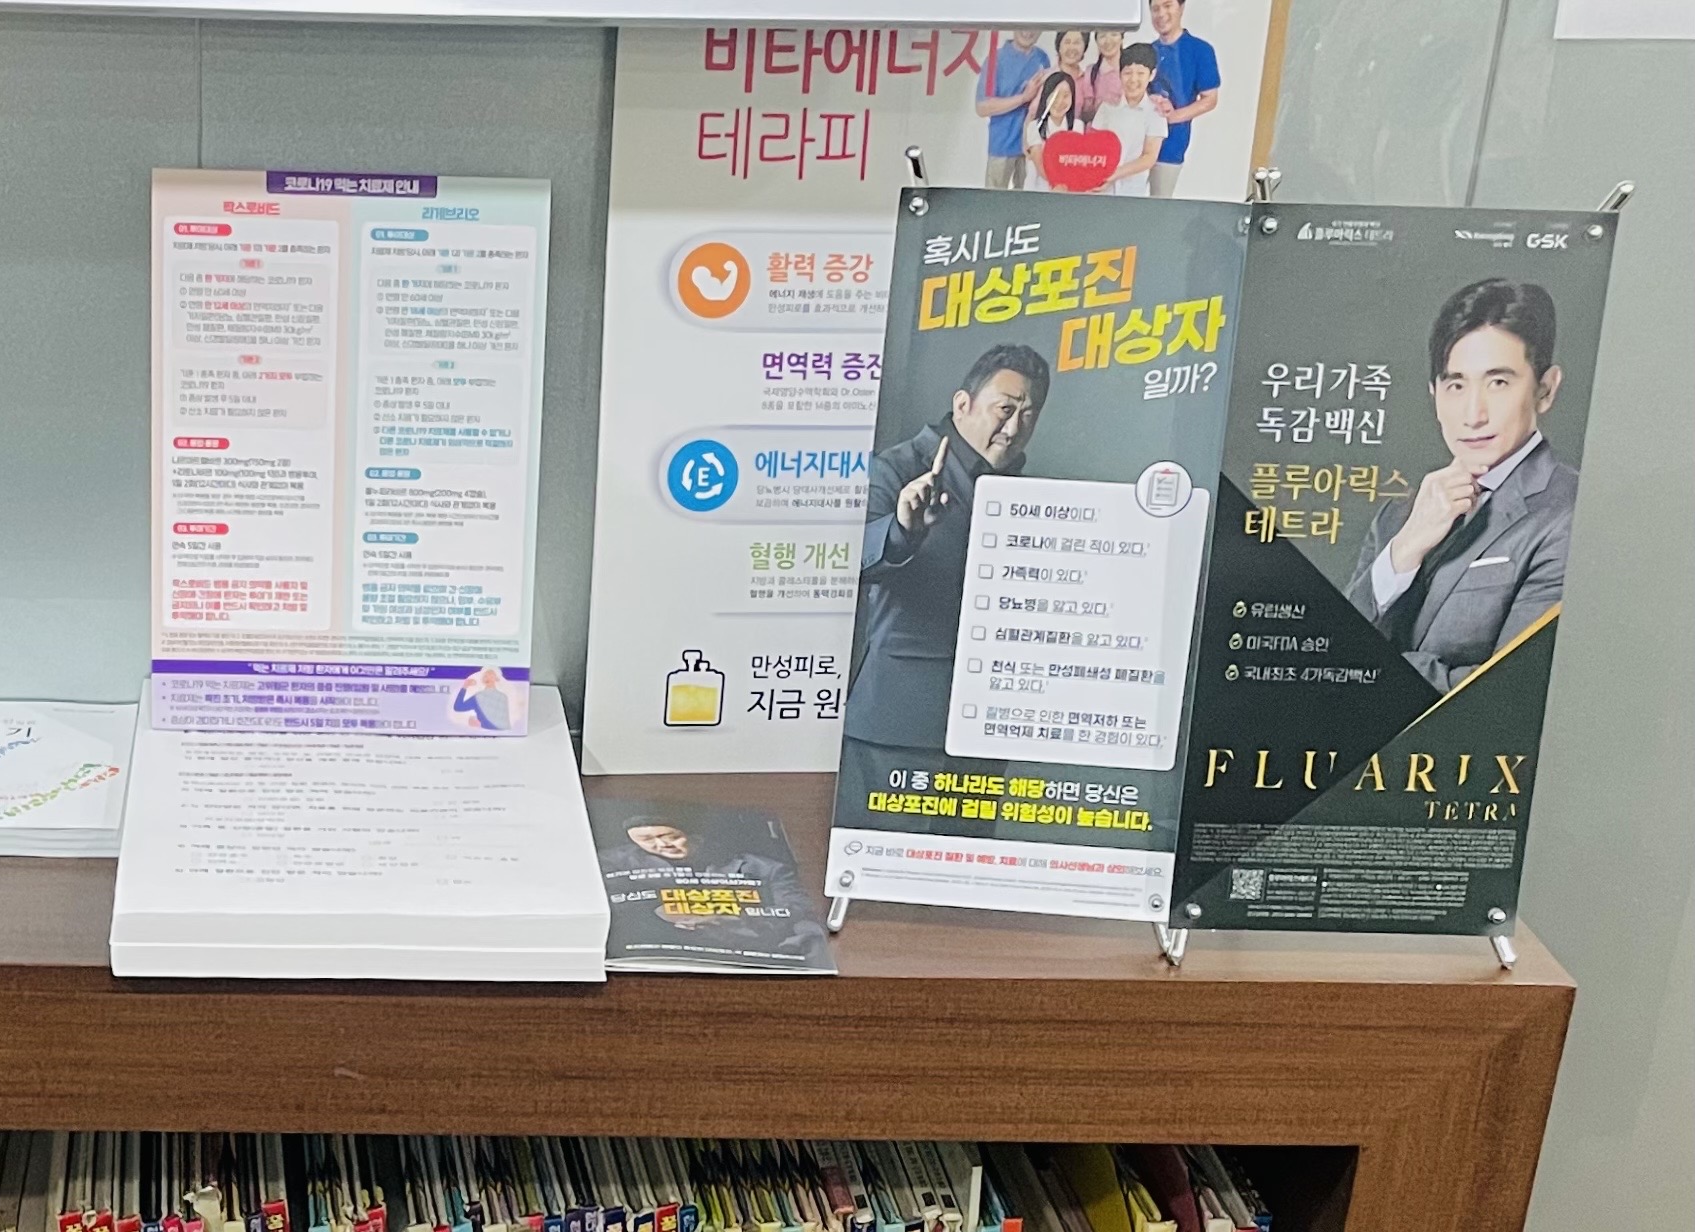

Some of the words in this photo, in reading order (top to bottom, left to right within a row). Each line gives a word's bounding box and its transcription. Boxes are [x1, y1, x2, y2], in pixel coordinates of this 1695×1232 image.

[704, 28, 998, 97] 비타에너지
[698, 108, 870, 180] 테라피
[396, 180, 419, 194] 안내
[1526, 232, 1569, 249] GSK
[767, 252, 815, 283] 활력
[824, 253, 873, 283] 증강
[918, 245, 1137, 331] 대상포진
[1057, 295, 1226, 372] 대상자
[763, 352, 832, 380] 면역력
[1143, 362, 1217, 400] 일까?
[1249, 464, 1410, 502] 플루아릭스
[1010, 503, 1041, 517] 50세
[1244, 508, 1342, 544] 테트라
[750, 542, 796, 570] 혈행
[804, 542, 849, 570] 개선
[751, 655, 841, 680] 만성피로,
[747, 688, 806, 720] 지금
[890, 769, 907, 790] 이
[911, 770, 930, 792] 중
[934, 772, 1004, 797] 하나라도
[1008, 777, 1081, 802] 해당하면
[1084, 782, 1139, 806] 당신은
[1204, 748, 1527, 795] FLUARIX
[868, 792, 957, 818] 대상포진에
[961, 798, 997, 820] 걸릴
[1001, 801, 1073, 825] 위험성이
[1076, 805, 1153, 833] 높습니다.
[1425, 800, 1517, 821] TETRA
[660, 888, 761, 903] 대상포진
[662, 902, 741, 916] 대상자
